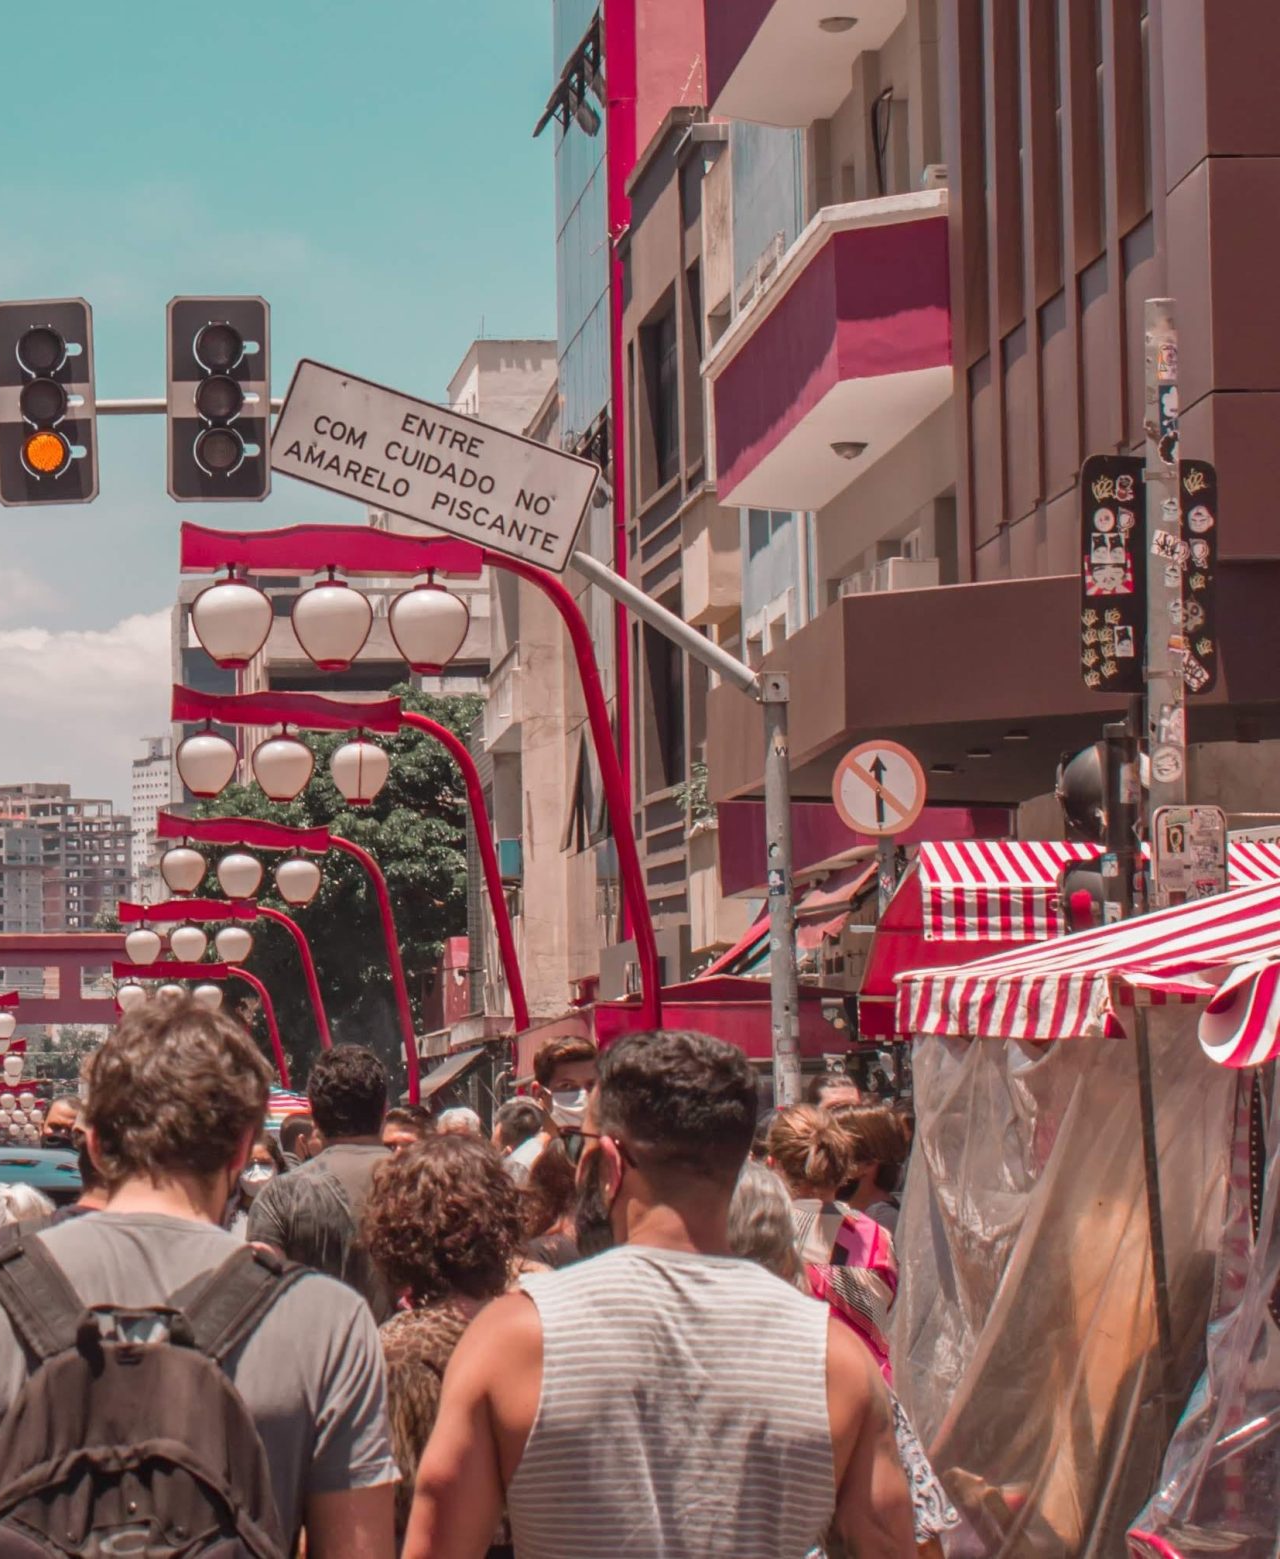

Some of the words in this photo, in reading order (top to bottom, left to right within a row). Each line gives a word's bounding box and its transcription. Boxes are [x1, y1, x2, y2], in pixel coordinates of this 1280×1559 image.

[313, 415, 368, 450] COM
[384, 441, 496, 495] CUIDADO
[515, 488, 551, 516] NO
[401, 412, 485, 459] ENTRE
[284, 440, 410, 498] AMARELO
[431, 492, 559, 554] PISCANTE
